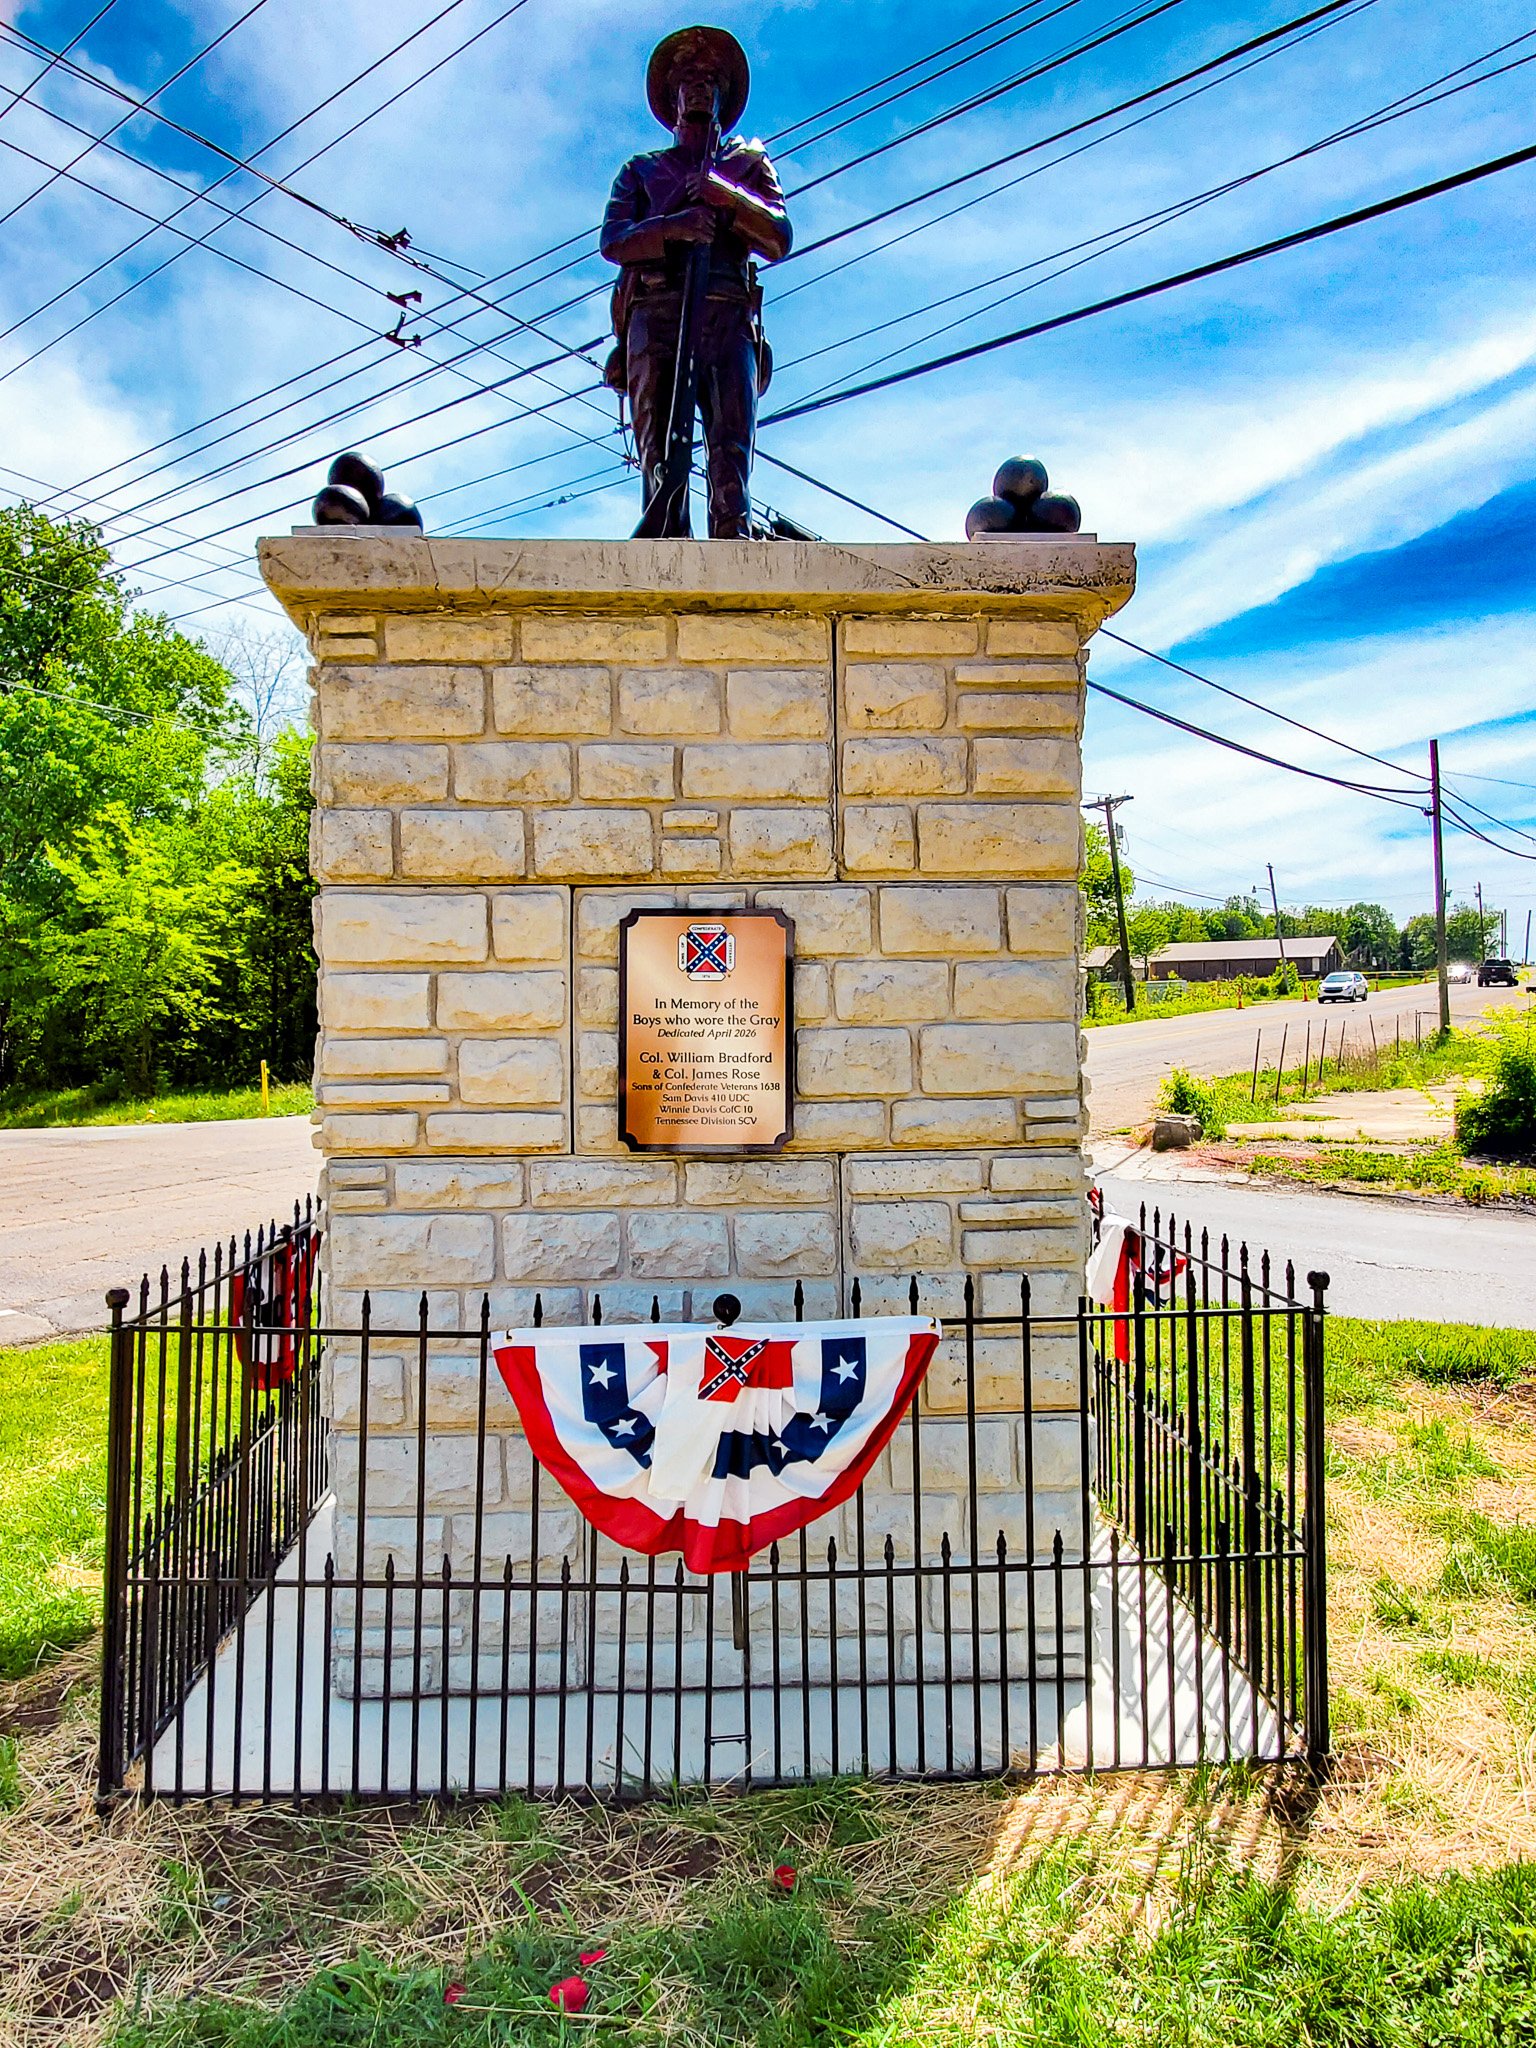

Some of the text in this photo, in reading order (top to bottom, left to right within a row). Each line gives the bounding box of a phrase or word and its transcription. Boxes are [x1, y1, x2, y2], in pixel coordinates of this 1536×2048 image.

[655, 998, 758, 1012] In Memory of the
[633, 1015, 780, 1028] Boys who wore the Gray
[658, 1029, 705, 1037] Dedicated
[707, 1029, 731, 1039] April
[640, 1052, 772, 1063] Col. William Bradford
[653, 1068, 760, 1081] & Col. James Rose
[701, 1117, 736, 1125] Division
[738, 1117, 757, 1125] SCV
